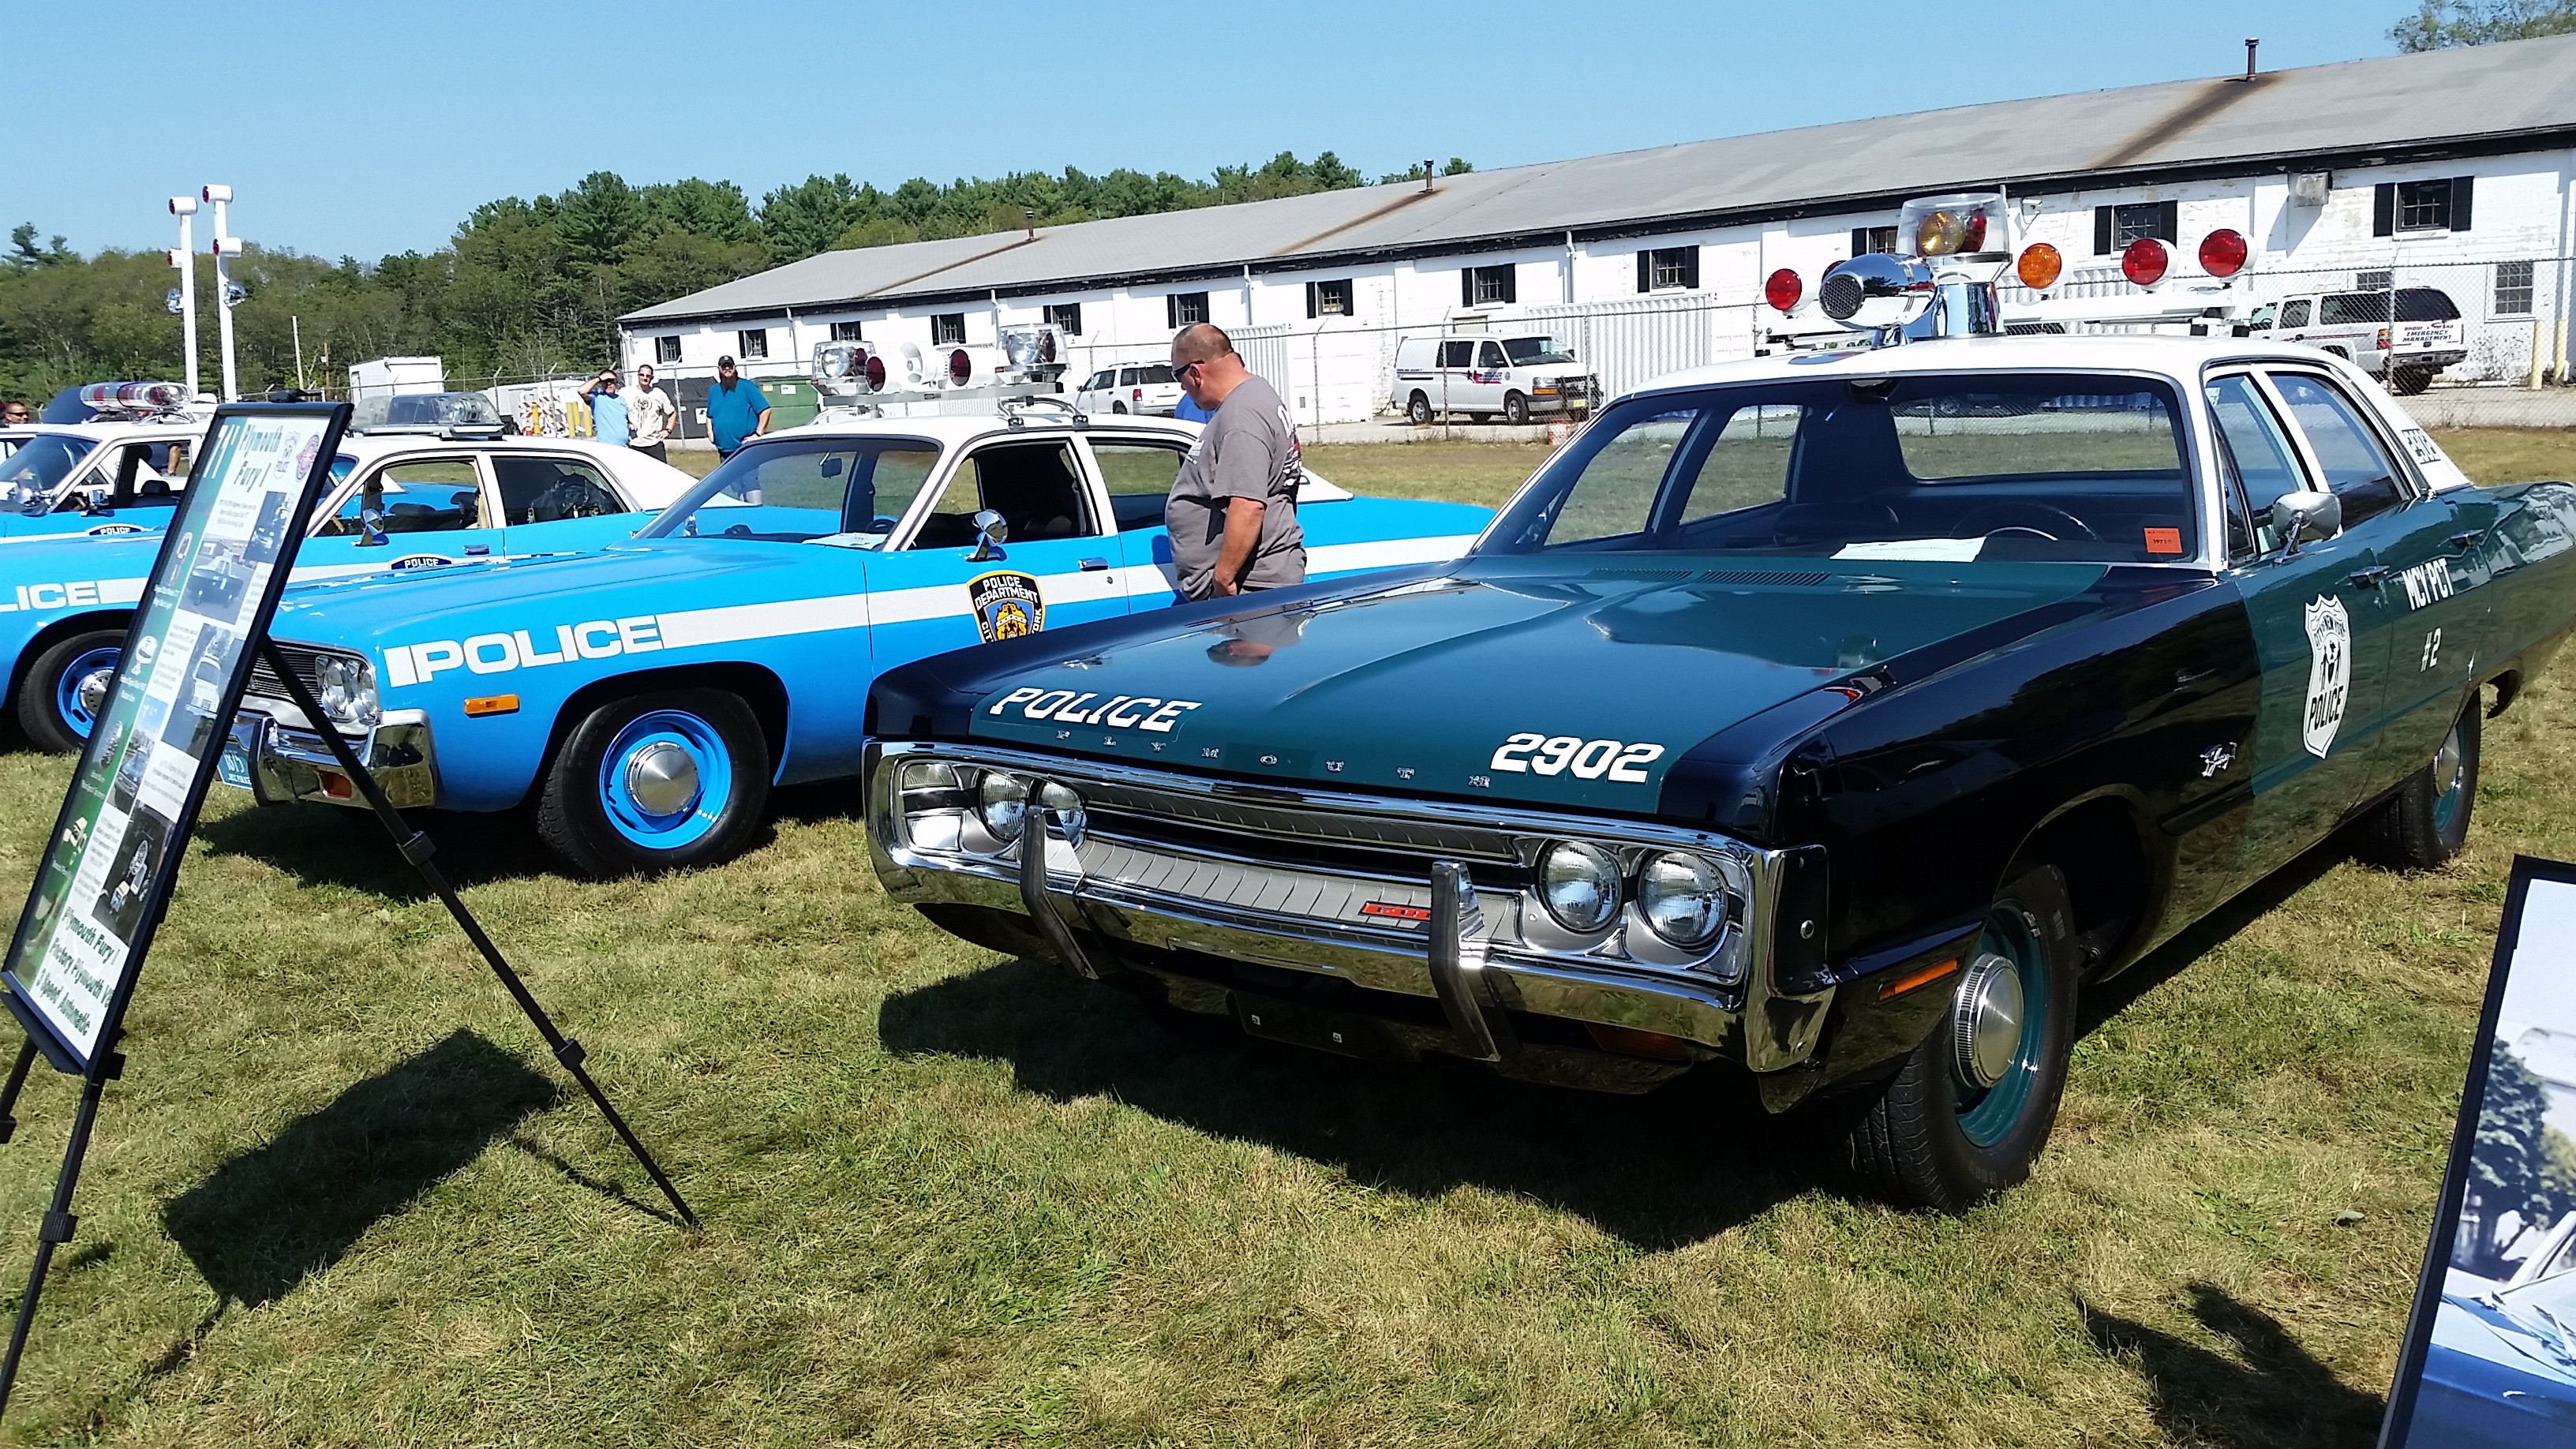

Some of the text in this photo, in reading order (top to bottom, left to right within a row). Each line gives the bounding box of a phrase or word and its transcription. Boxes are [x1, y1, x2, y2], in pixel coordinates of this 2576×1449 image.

[239, 425, 283, 458] Plymouth
[234, 461, 262, 492] Fury
[404, 557, 439, 568] POLICE
[983, 576, 1022, 591] POLICE
[2402, 558, 2454, 611] MCY PCT
[975, 587, 1039, 611] DEPARTMENT
[410, 615, 664, 683] POLICE
[2421, 627, 2442, 672] #2
[989, 687, 1203, 732] POLICE
[2307, 685, 2344, 733] POLICE
[1056, 730, 1490, 788] PLYMOUTH
[1490, 732, 1665, 783] 2902
[62, 906, 96, 945] Plymouth
[93, 934, 114, 964] Fury
[50, 938, 74, 974] Factory
[71, 957, 105, 998] Plymouth
[40, 972, 64, 1004] Speed
[58, 992, 91, 1036] Automatic
